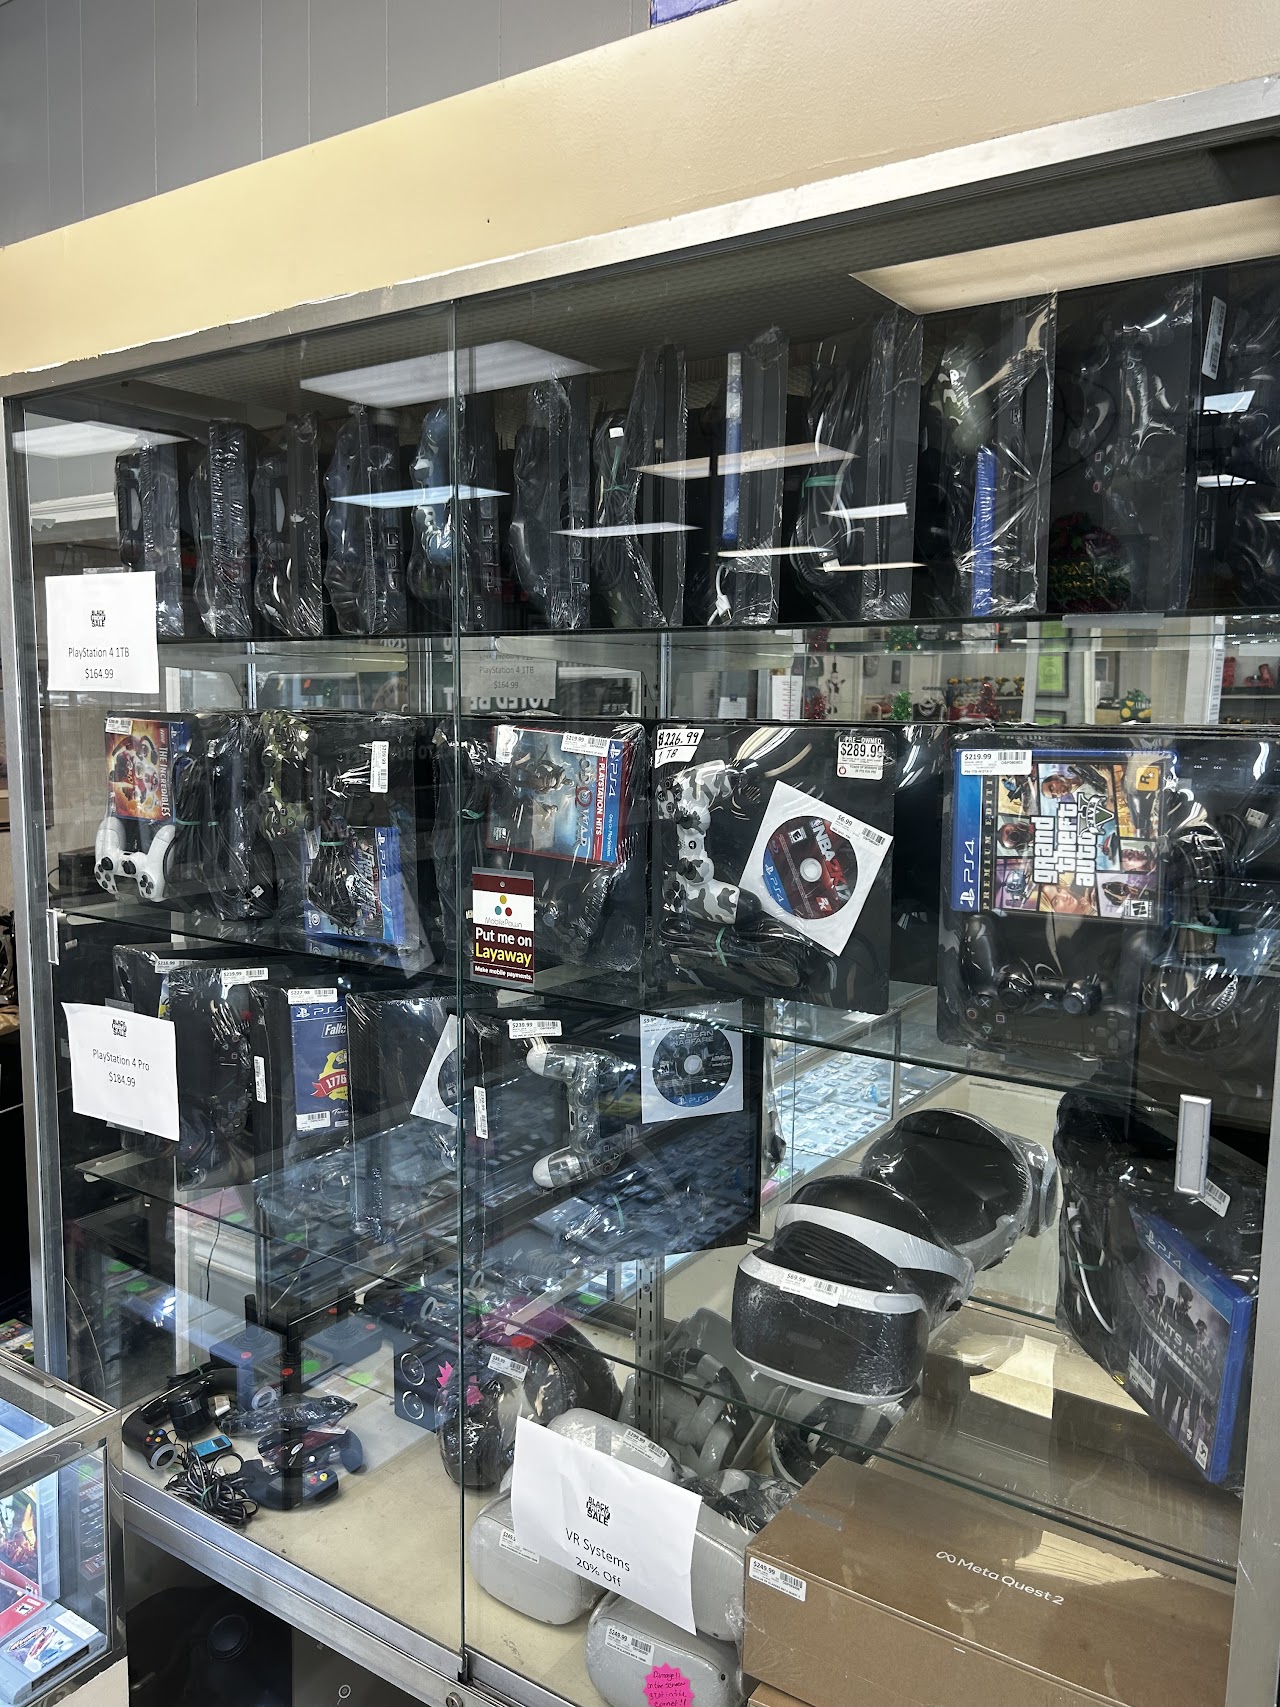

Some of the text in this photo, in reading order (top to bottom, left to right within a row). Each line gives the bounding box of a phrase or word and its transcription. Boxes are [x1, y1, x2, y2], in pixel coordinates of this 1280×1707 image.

[68, 647, 130, 660] PlayStation 4 1TB
[84, 668, 114, 679] $164.99
[479, 666, 514, 675] PlayStation
[658, 732, 700, 746] $226.99
[159, 747, 168, 760] THE
[840, 742, 883, 758] $289.99
[160, 762, 171, 817] INCREDIBLES
[608, 762, 619, 797] PS4
[595, 762, 606, 836] PLAYSTATION HITS
[812, 824, 836, 862] NBA
[982, 780, 993, 911] PREMIUM EDITI
[1055, 802, 1078, 873] theft
[1031, 815, 1059, 884] grand
[1076, 832, 1097, 887] auto
[379, 850, 387, 880] PS4
[964, 840, 975, 882] PS4
[770, 877, 784, 902] PS4
[484, 916, 522, 928] MobilePawn
[475, 926, 532, 948] Put me on
[475, 942, 532, 968] Layaway
[474, 966, 488, 974] Make
[488, 968, 506, 976] mobile
[314, 1006, 344, 1016] PS4
[669, 1030, 714, 1040] MODERN
[670, 1036, 714, 1047] WARFARE
[92, 1048, 150, 1071] PlayStation 4 Pro
[108, 1071, 136, 1088] $184.99
[326, 1074, 347, 1088] 1776
[688, 1095, 710, 1103] PS4
[1156, 1244, 1182, 1271] PS4
[588, 1496, 610, 1512] BLACK
[586, 1508, 609, 1526] SALE
[565, 1527, 630, 1572] VR Systems
[576, 1556, 622, 1587] 20% Off
[753, 1560, 776, 1575] $249.99
[958, 1558, 1065, 1606] Meta Quest 2
[608, 1628, 628, 1642] $249.99
